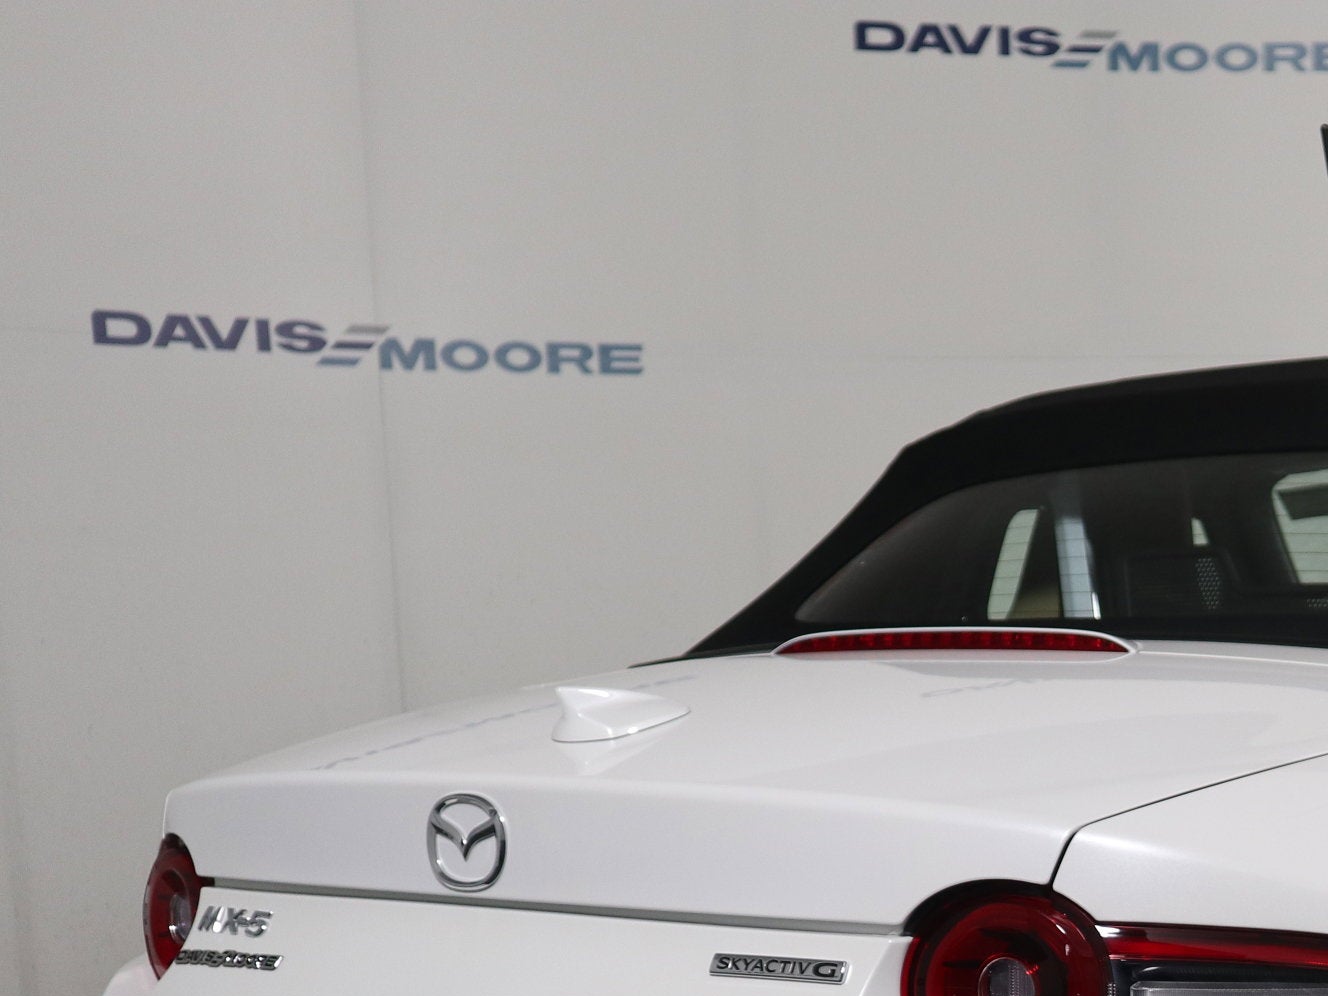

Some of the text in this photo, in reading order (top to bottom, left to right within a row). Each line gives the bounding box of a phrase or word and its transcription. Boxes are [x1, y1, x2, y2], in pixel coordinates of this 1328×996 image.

[854, 20, 1060, 56] DAVIS
[91, 309, 645, 375] DAVIS MOORE
[198, 906, 273, 938] MX-5
[717, 957, 811, 975] SKYACTIV
